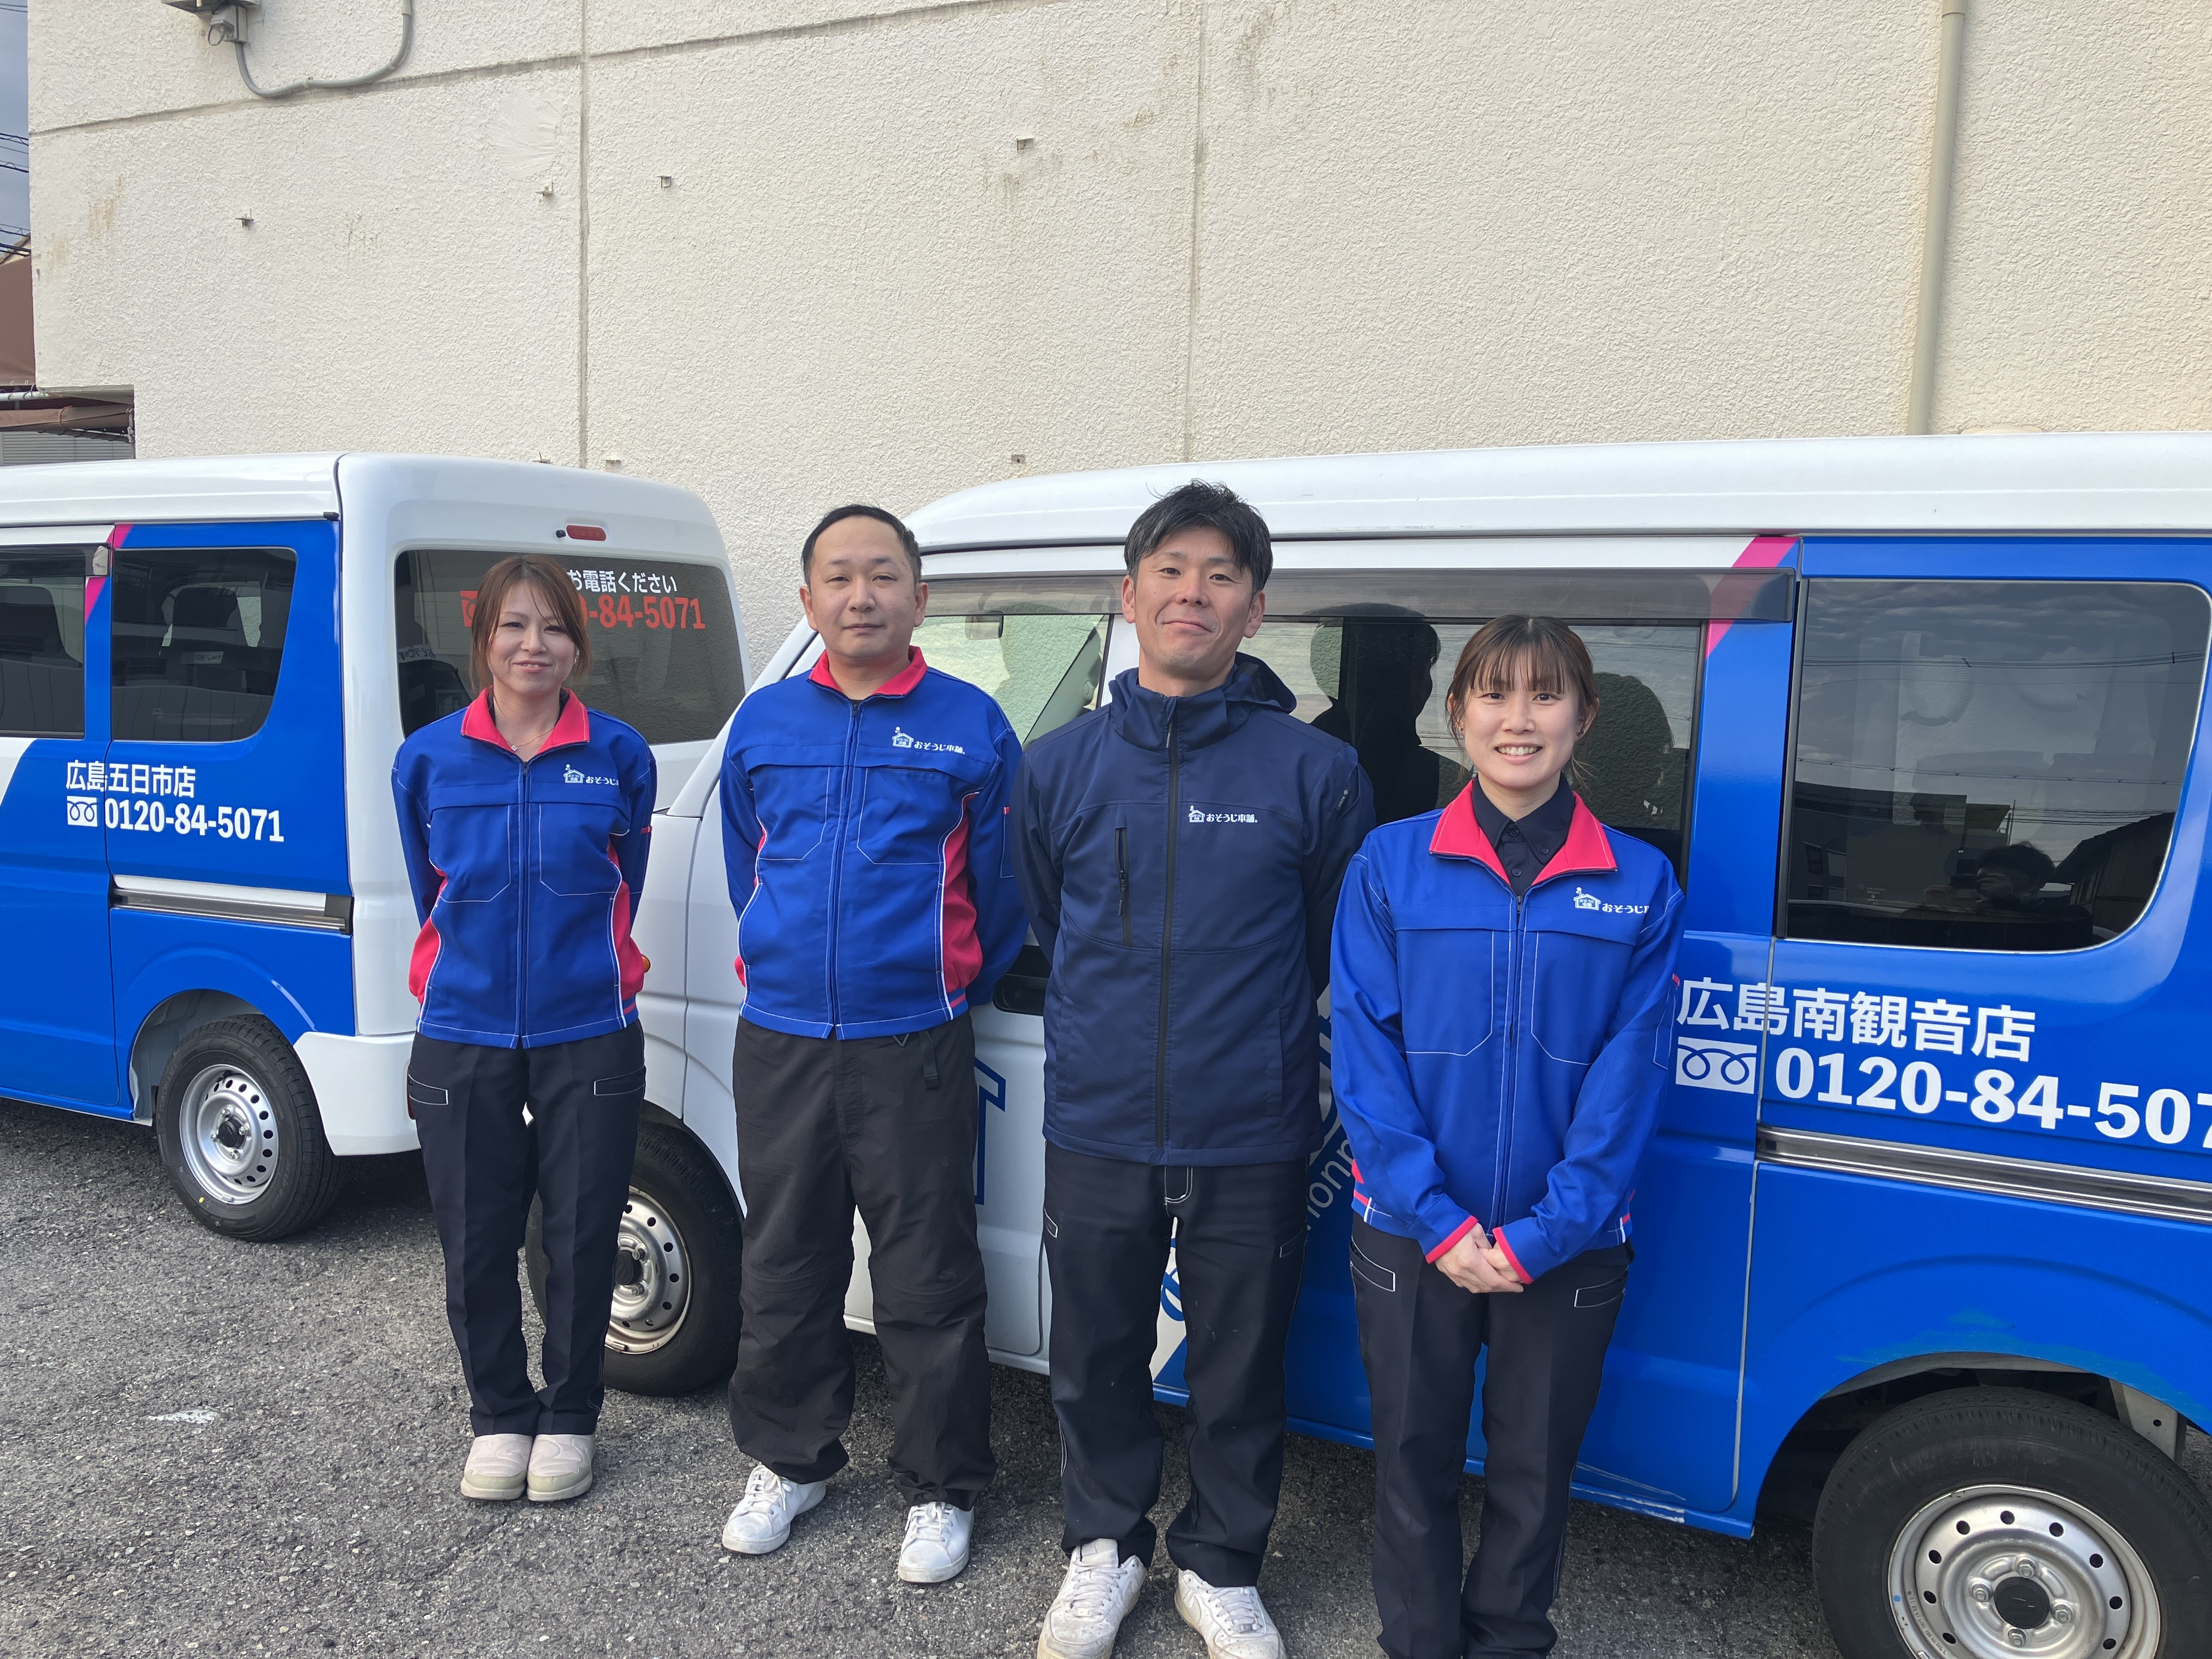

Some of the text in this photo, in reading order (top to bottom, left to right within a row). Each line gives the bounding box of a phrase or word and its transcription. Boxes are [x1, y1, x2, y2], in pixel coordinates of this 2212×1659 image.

[66, 759, 196, 798] 広島五日市店
[104, 798, 285, 843] 0120-84-5071
[1677, 977, 2036, 1063] 広島南観音店
